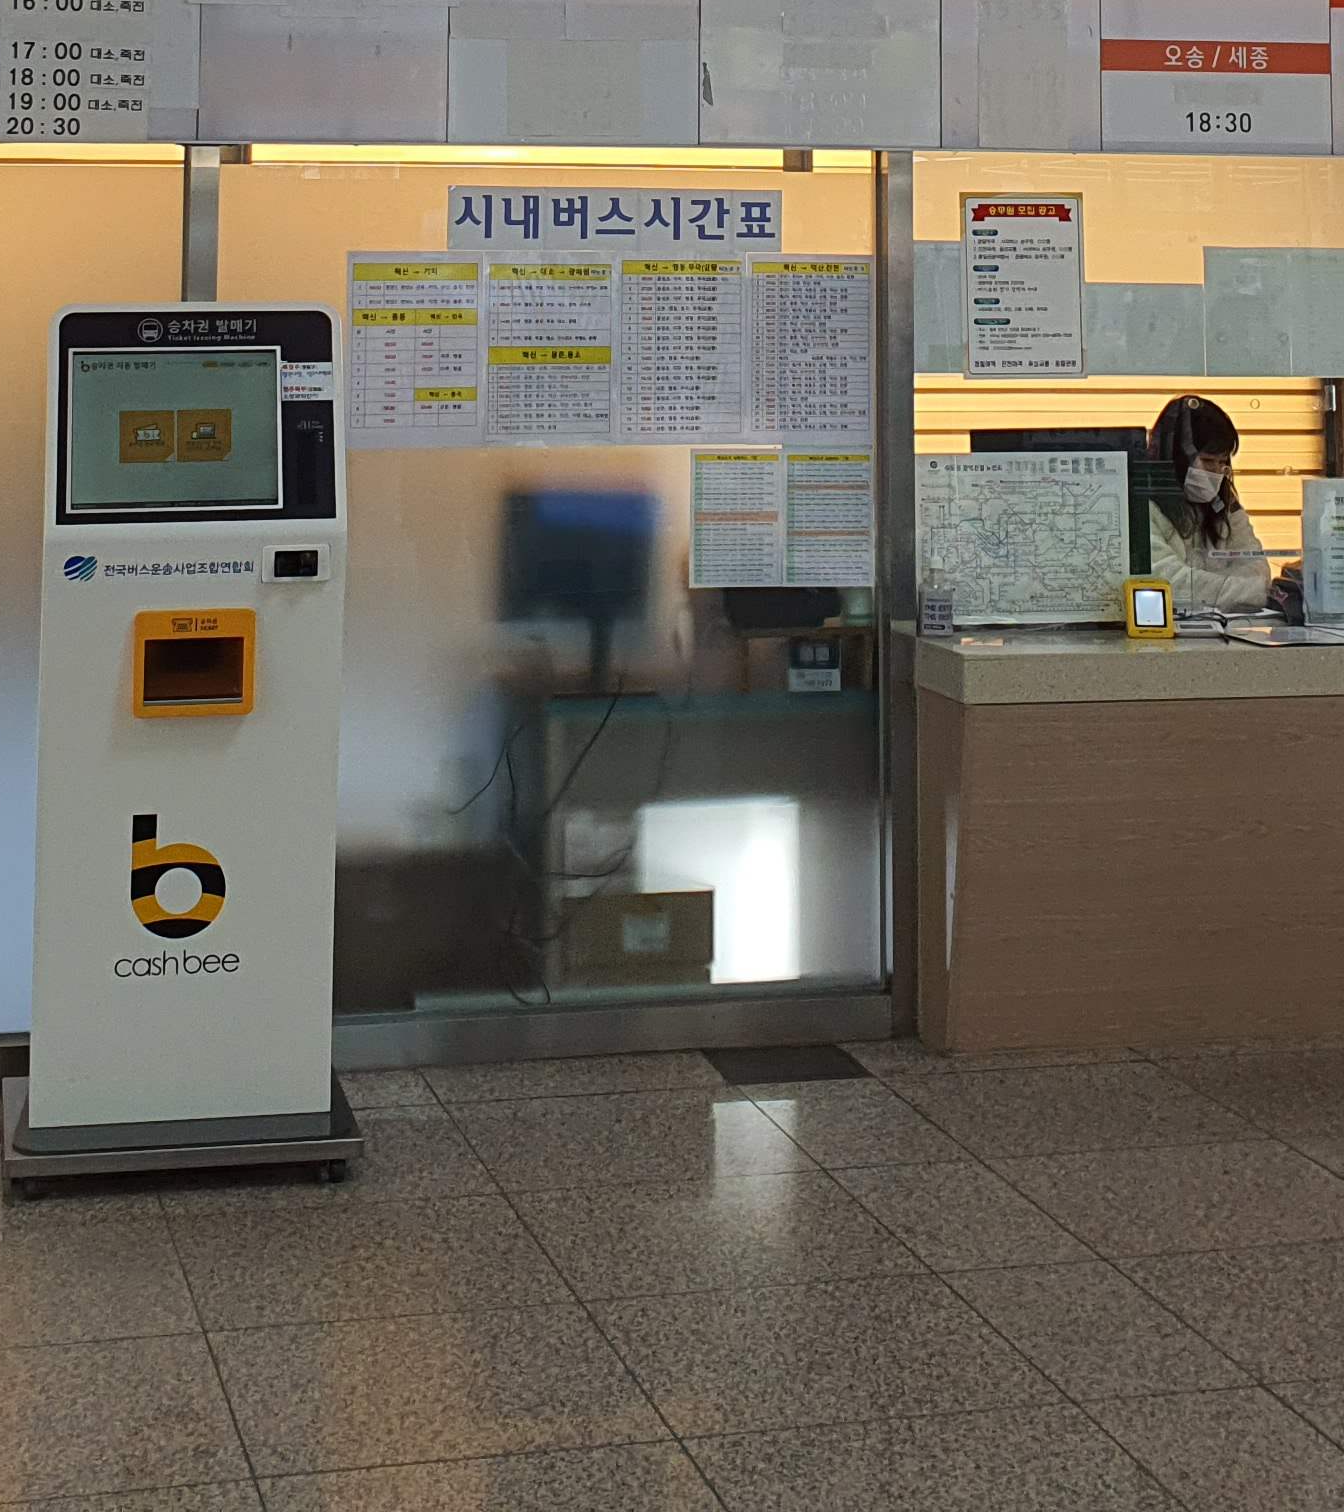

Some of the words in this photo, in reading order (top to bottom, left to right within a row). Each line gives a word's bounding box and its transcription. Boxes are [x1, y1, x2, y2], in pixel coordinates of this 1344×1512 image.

[12, 42, 81, 60] 17:00
[10, 68, 80, 86] 18:00
[10, 93, 80, 110] 19:00
[7, 117, 80, 135] 20:30
[1187, 112, 1251, 132] 18:30
[455, 195, 775, 240] 시내버스시간표
[167, 318, 210, 334] 승차권
[216, 318, 257, 333] 발매기
